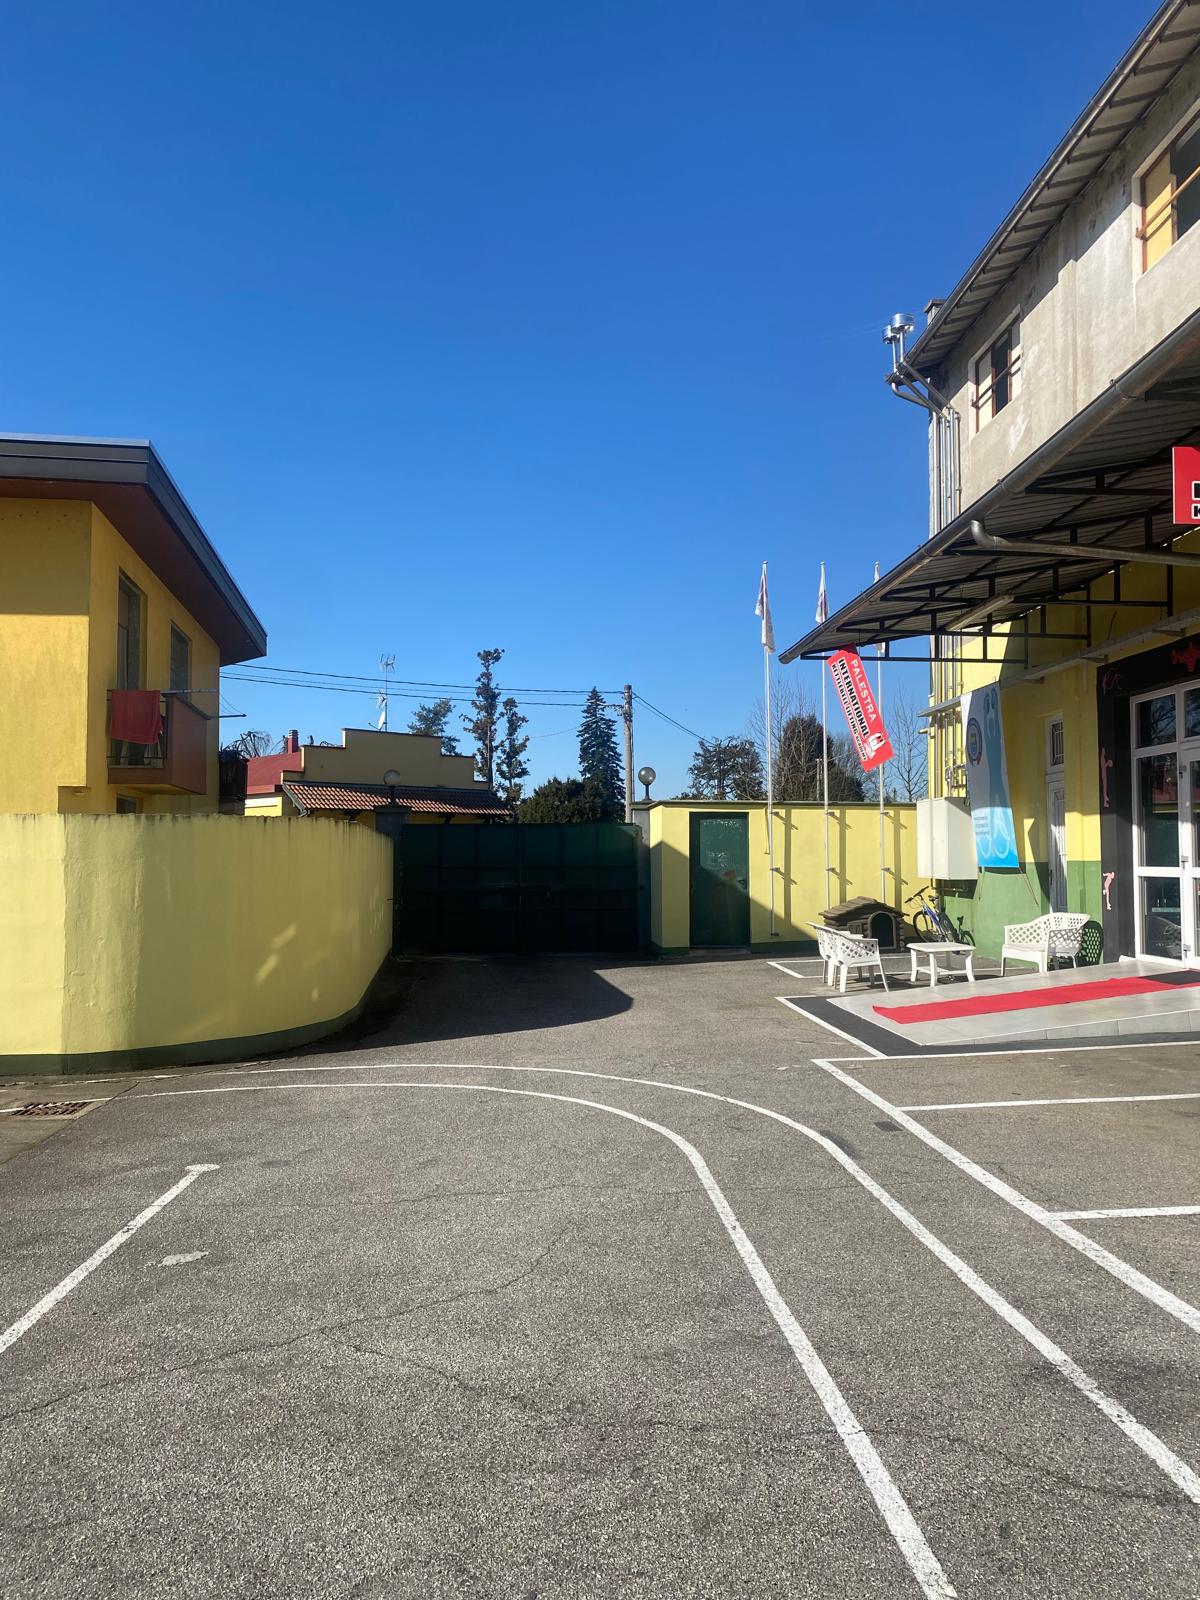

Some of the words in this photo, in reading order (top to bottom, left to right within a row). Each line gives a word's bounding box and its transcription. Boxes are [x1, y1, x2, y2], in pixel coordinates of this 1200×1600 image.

[831, 663, 848, 705] KETTLEBELL
[845, 705, 859, 735] LIFTING
[838, 658, 870, 738] INTERNATIONAL
[850, 658, 877, 723] PALESTRA
